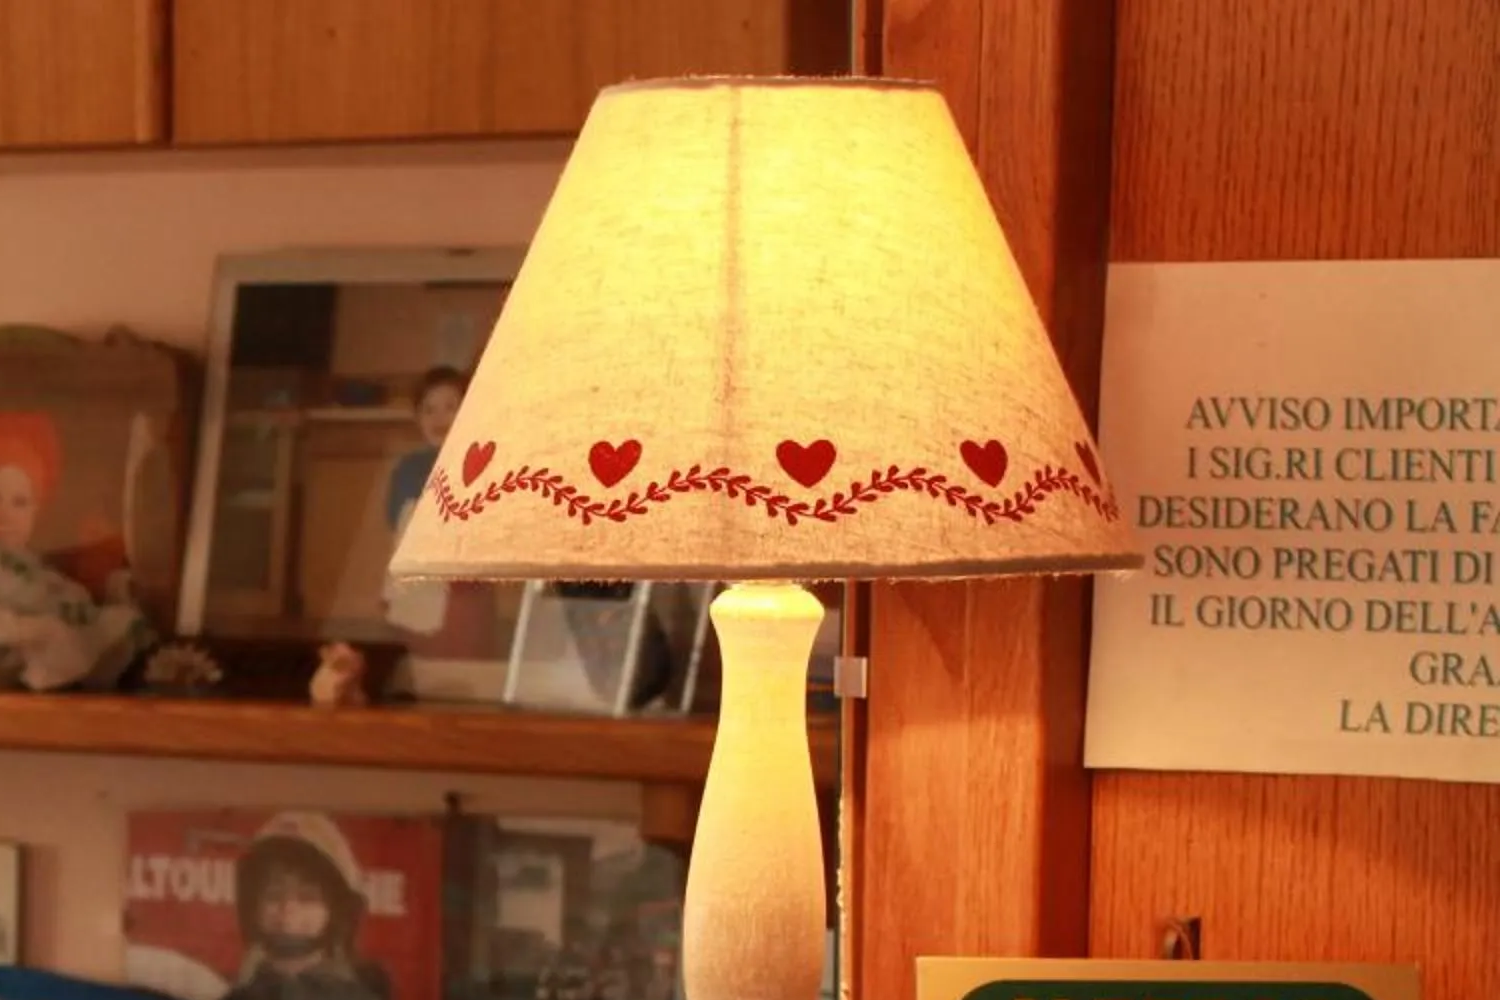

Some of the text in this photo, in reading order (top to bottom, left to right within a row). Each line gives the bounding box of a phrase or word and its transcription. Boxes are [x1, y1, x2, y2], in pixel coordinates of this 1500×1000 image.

[1185, 396, 1500, 433] AVVISO IMPORT
[1186, 446, 1497, 483] I SIG.RI CLIENTI
[1137, 495, 1394, 533] DESIDERANO
[1405, 499, 1460, 533] LA
[1153, 544, 1494, 585] SONO PREGATI DI
[1150, 593, 1184, 627] IL
[1195, 594, 1354, 631] GIORNO
[1408, 650, 1500, 687] GRA
[1340, 698, 1500, 738] LA DIRE
